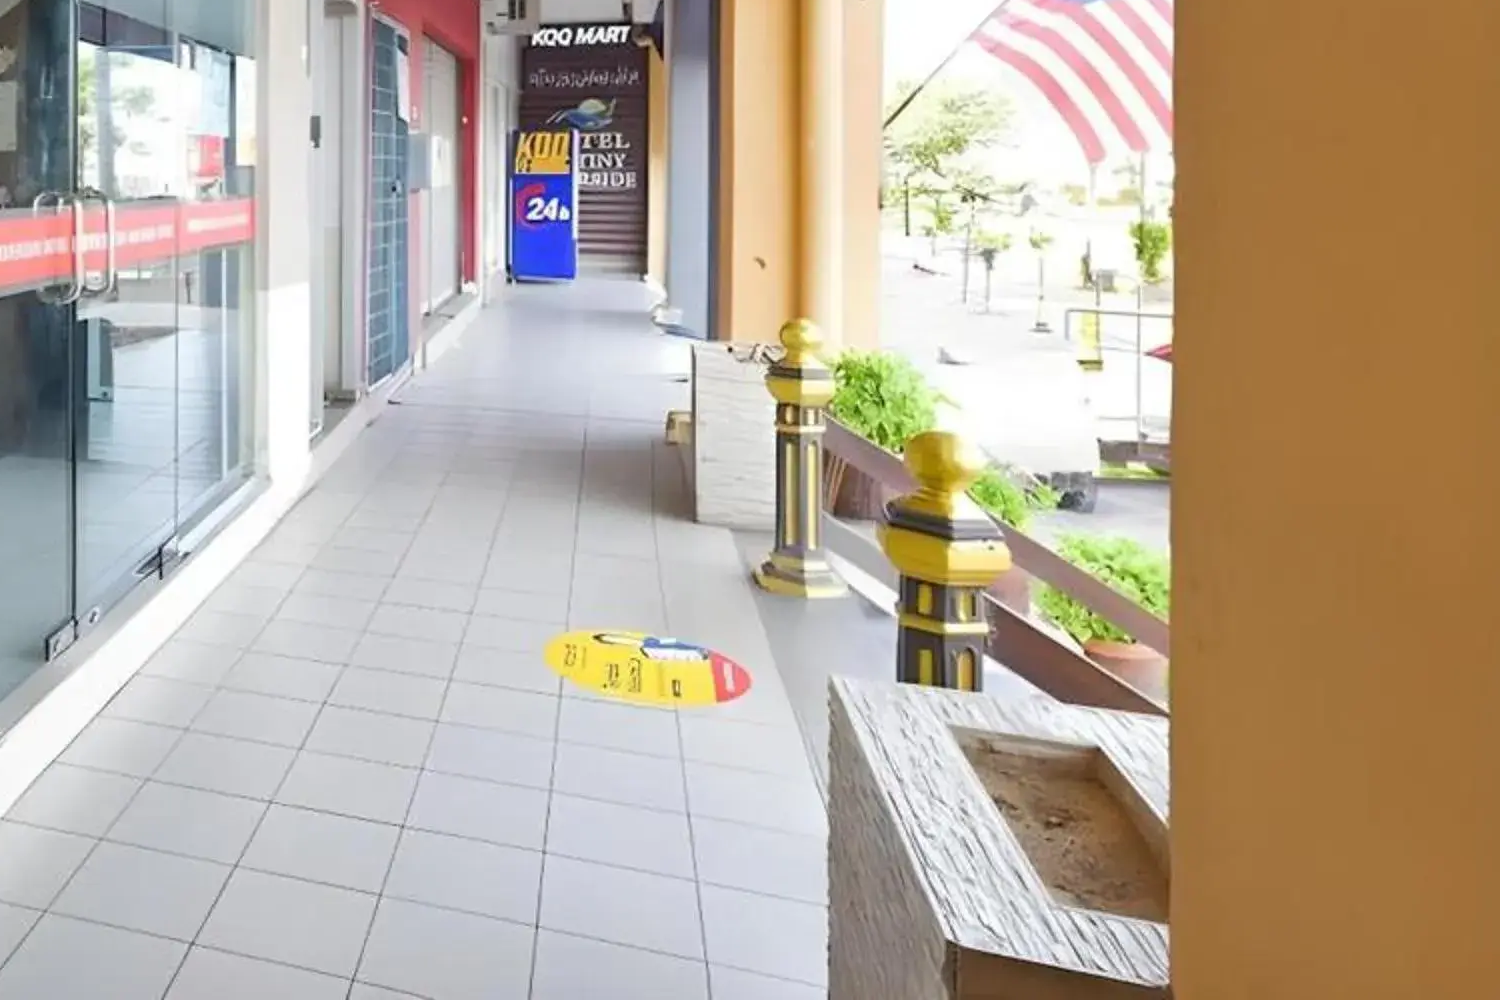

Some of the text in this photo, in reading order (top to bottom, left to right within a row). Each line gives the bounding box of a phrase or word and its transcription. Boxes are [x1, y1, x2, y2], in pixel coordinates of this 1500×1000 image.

[574, 25, 631, 45] MART
[580, 132, 631, 149] TEL
[580, 152, 627, 169] TINY
